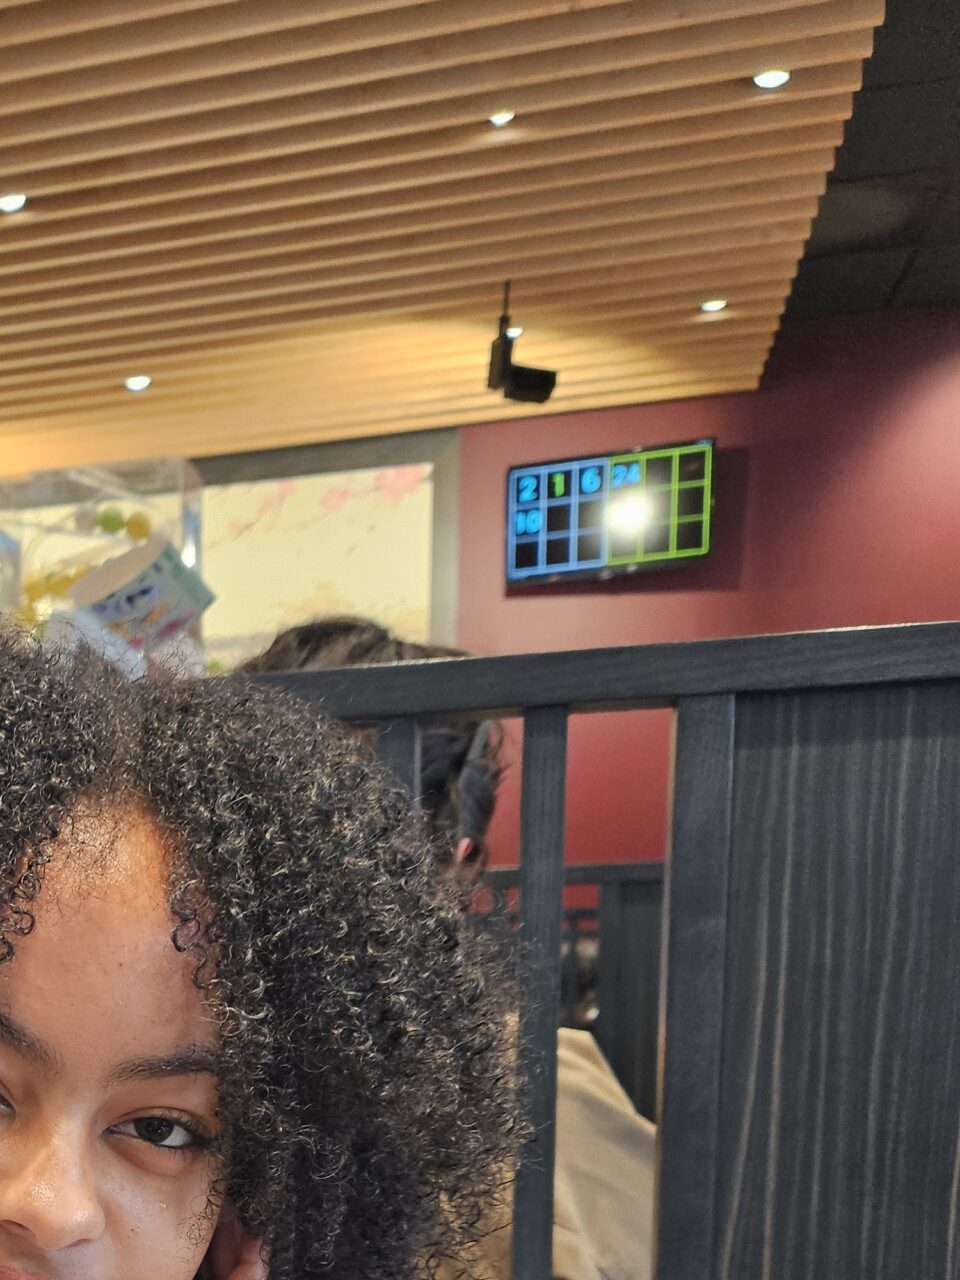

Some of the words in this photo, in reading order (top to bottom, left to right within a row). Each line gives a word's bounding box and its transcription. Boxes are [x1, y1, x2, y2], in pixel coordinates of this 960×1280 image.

[518, 475, 538, 502] 2
[552, 471, 566, 497] 1
[580, 466, 602, 494] 6
[612, 462, 641, 489] 24
[515, 509, 543, 536] 10
